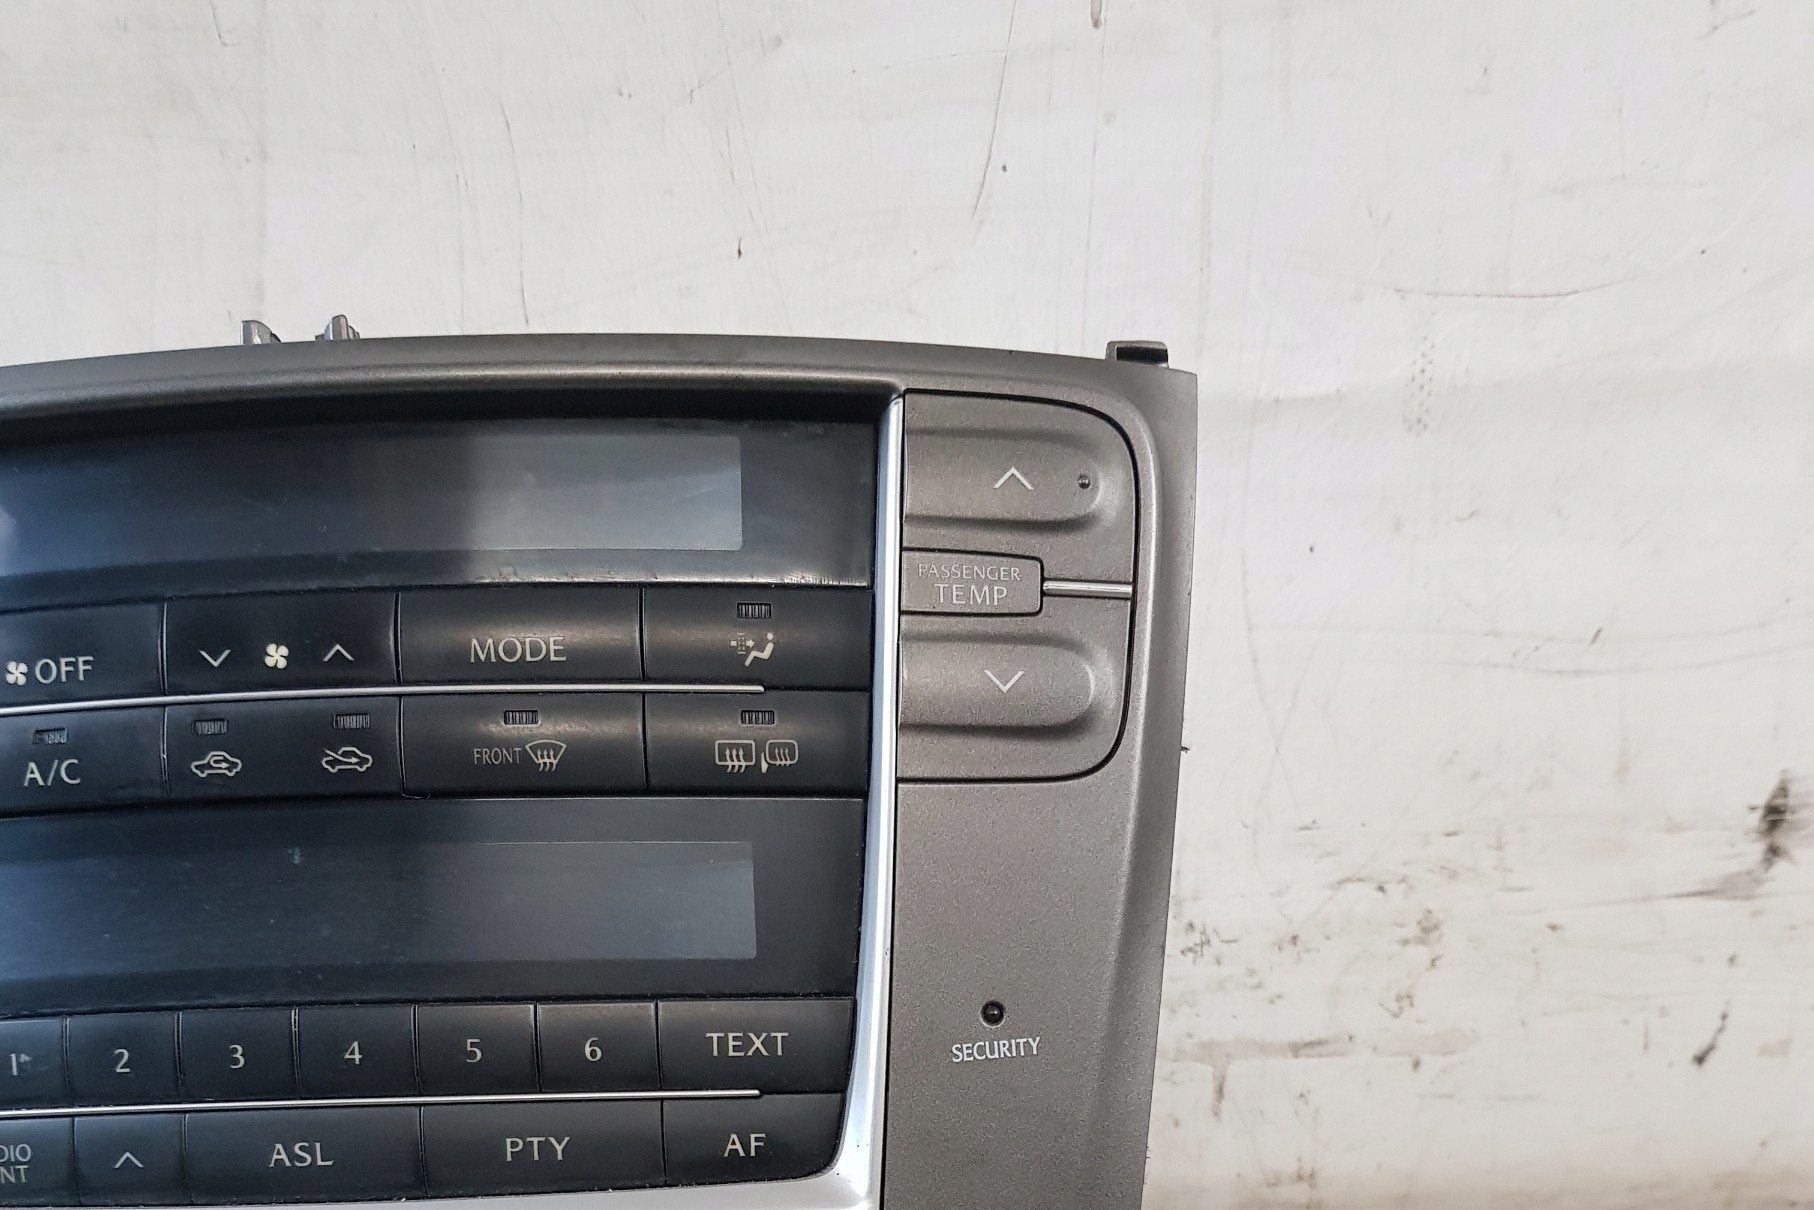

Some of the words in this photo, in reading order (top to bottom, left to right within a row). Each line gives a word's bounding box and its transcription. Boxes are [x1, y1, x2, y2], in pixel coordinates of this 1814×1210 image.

[917, 562, 1021, 582] PASSENGER
[933, 583, 1009, 607] TEMP
[469, 635, 568, 664] MODE
[34, 655, 94, 684] OFF
[473, 747, 523, 766] FRONT
[23, 758, 82, 788] A/C
[228, 1044, 246, 1070] 3
[343, 1041, 363, 1066] 4
[465, 1038, 483, 1063] 5
[584, 1036, 603, 1063] 6
[705, 1031, 790, 1058] TEXT
[951, 1036, 1041, 1063] SECURITY
[113, 1048, 132, 1074] 2
[268, 1141, 335, 1169] ASL
[504, 1135, 571, 1163] PTY
[723, 1132, 767, 1159] AF
